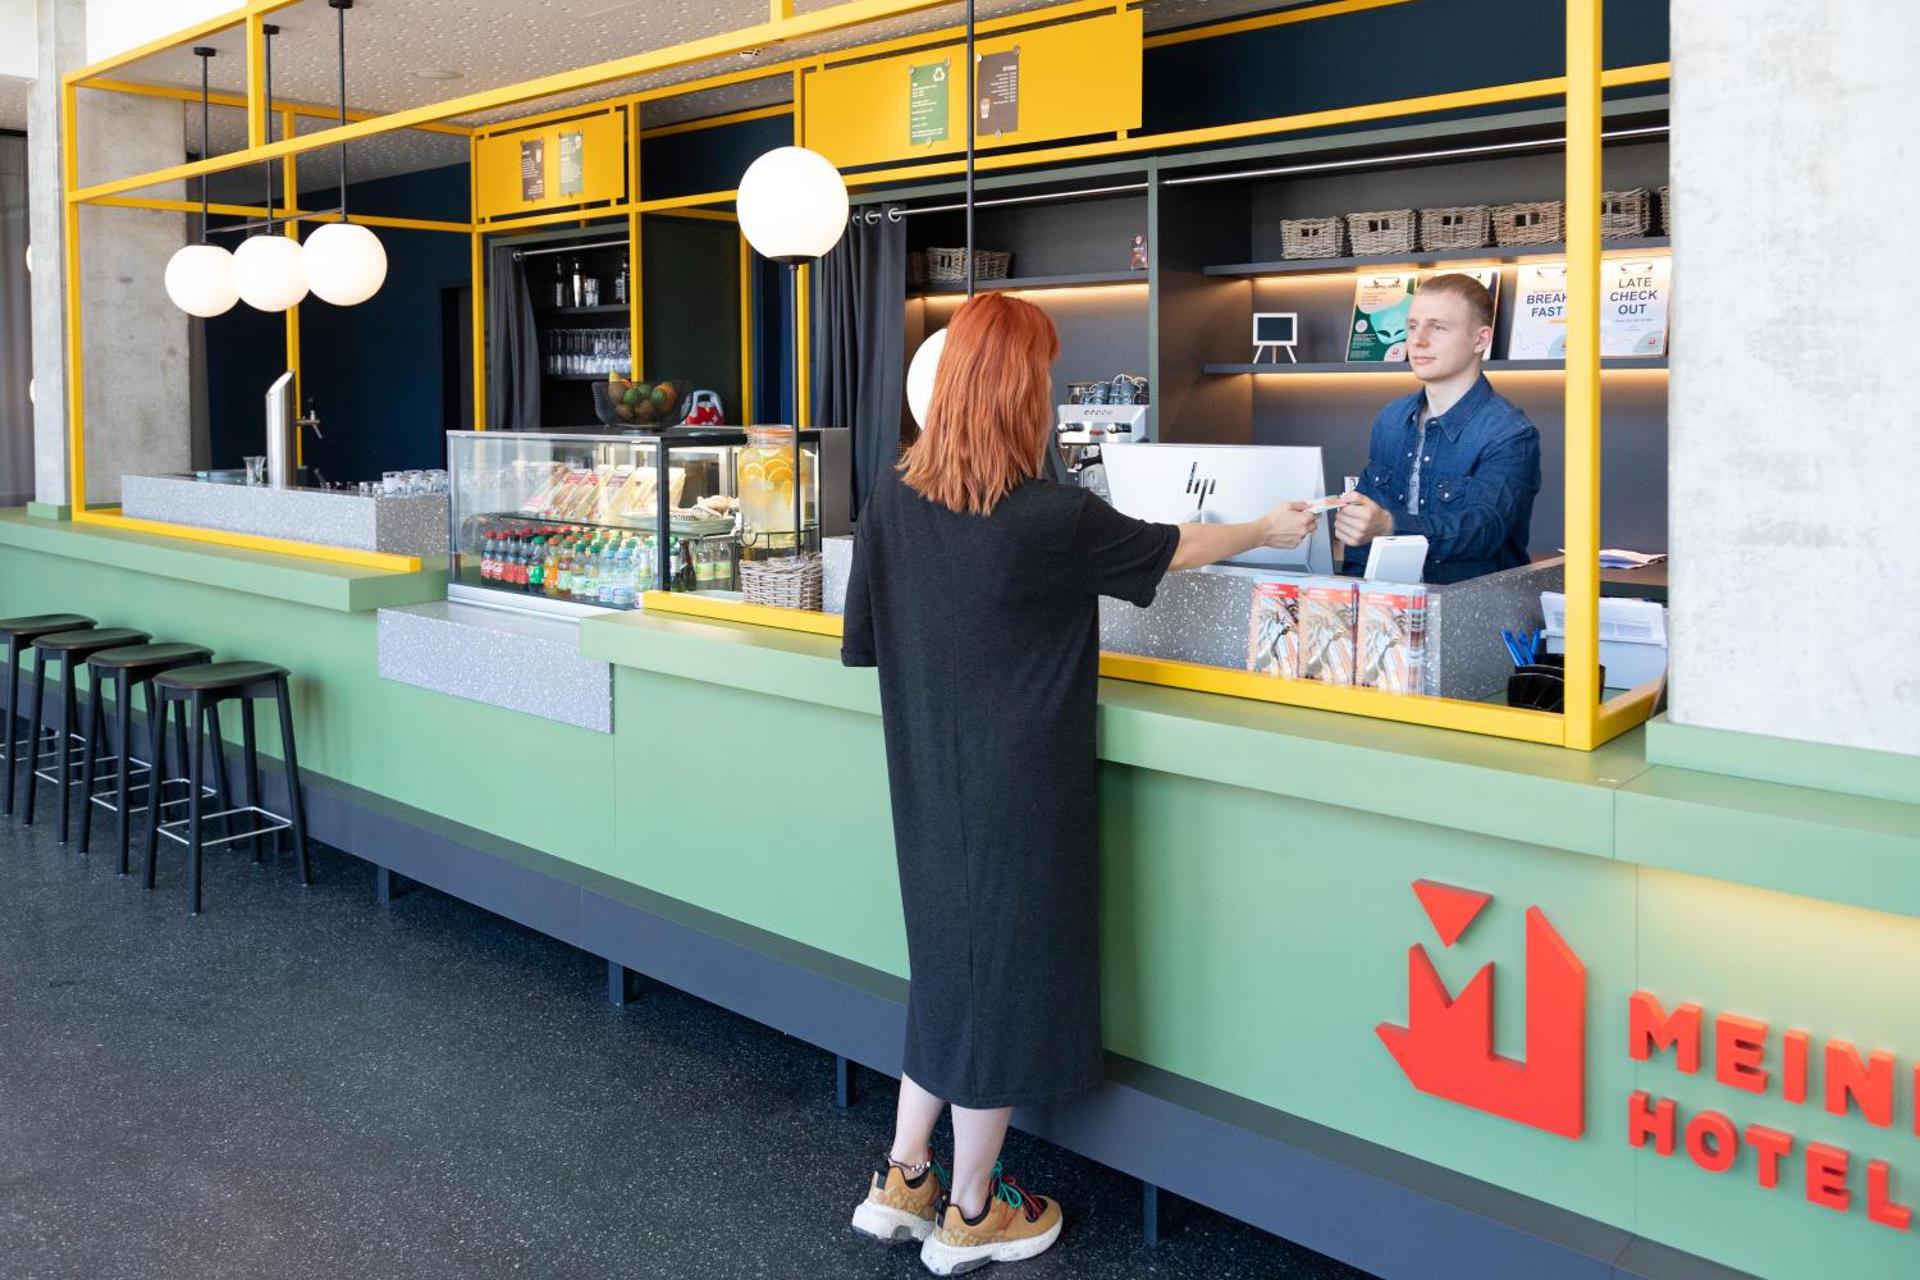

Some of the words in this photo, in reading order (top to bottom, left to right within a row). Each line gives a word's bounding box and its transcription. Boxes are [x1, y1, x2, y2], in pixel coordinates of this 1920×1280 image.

[1619, 277, 1652, 289] LATE
[1610, 290, 1658, 302] CHECK
[1531, 306, 1563, 318] FAST
[1618, 304, 1647, 315] OUT
[1186, 461, 1217, 511] hp
[1628, 989, 1920, 1140] MEIN
[1628, 1089, 1911, 1231] HOTEL
